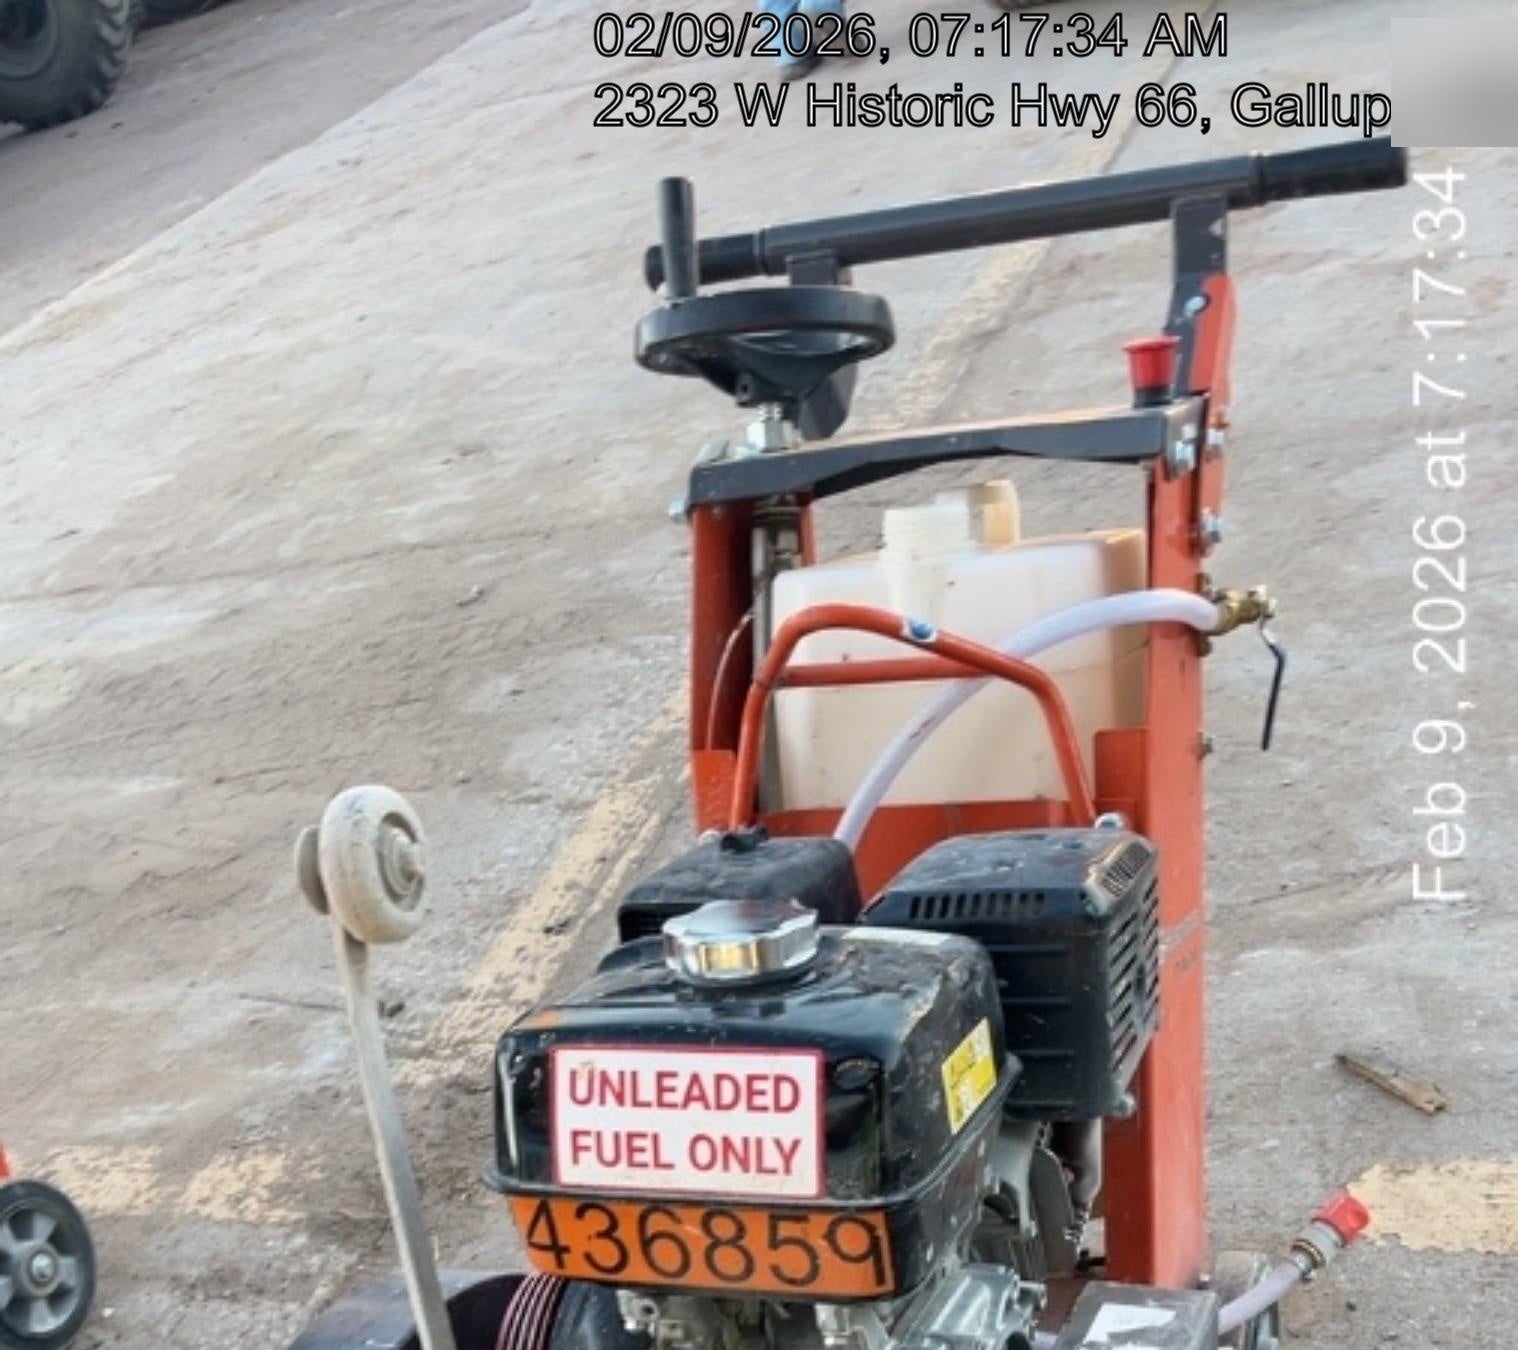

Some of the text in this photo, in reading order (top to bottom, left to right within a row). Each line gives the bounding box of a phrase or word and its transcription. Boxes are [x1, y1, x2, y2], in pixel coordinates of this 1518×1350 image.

[567, 1068, 801, 1114] UNLEADED
[569, 1129, 802, 1176] FUEL ONLY
[526, 1199, 888, 1289] 436859
